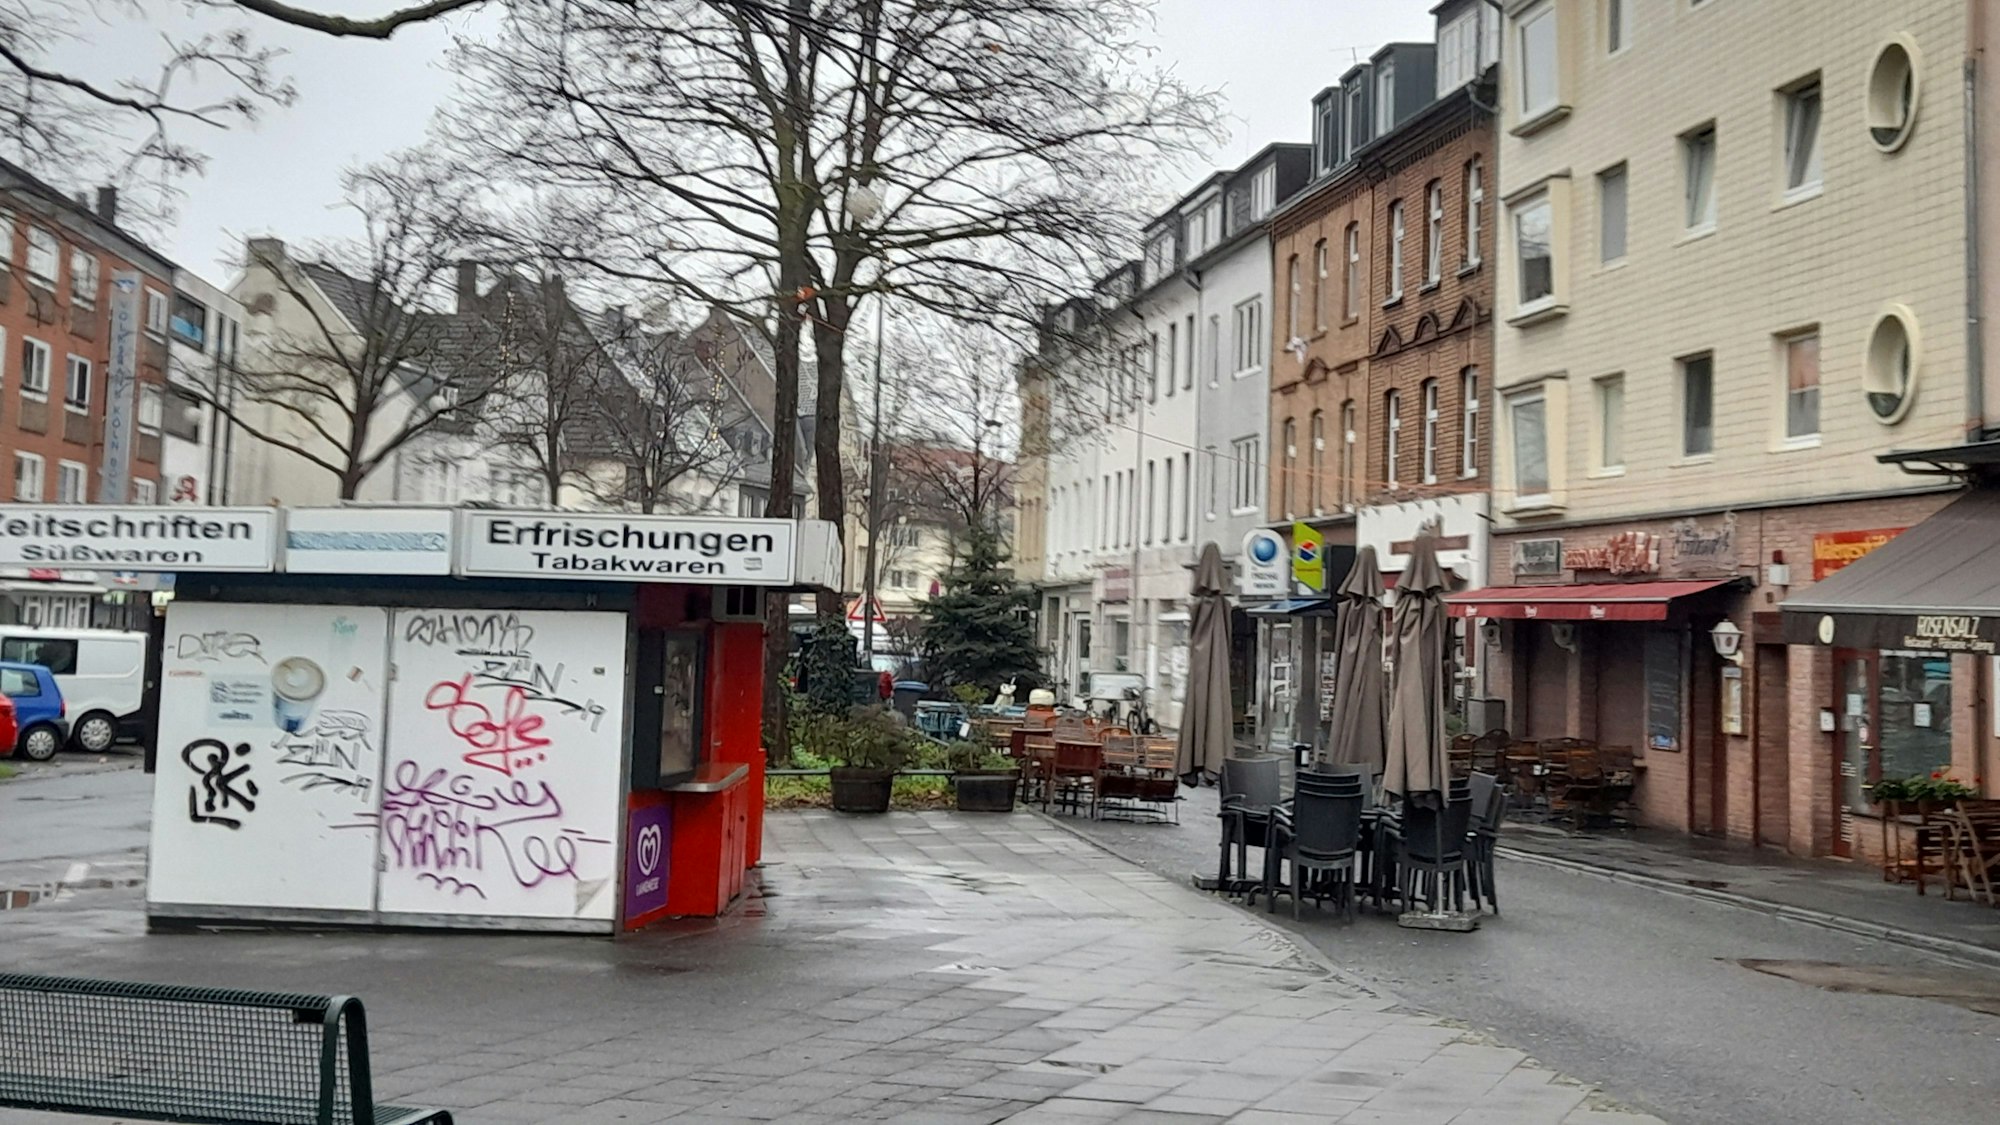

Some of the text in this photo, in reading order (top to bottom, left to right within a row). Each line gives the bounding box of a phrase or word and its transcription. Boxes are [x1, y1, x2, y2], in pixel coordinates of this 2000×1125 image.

[0, 514, 251, 539] eitschriften
[489, 519, 773, 557] Erfrischungen
[20, 544, 202, 562] Süßwaren
[531, 551, 726, 574] Tabakwaren
[1916, 615, 1980, 638] ROSENSALZ
